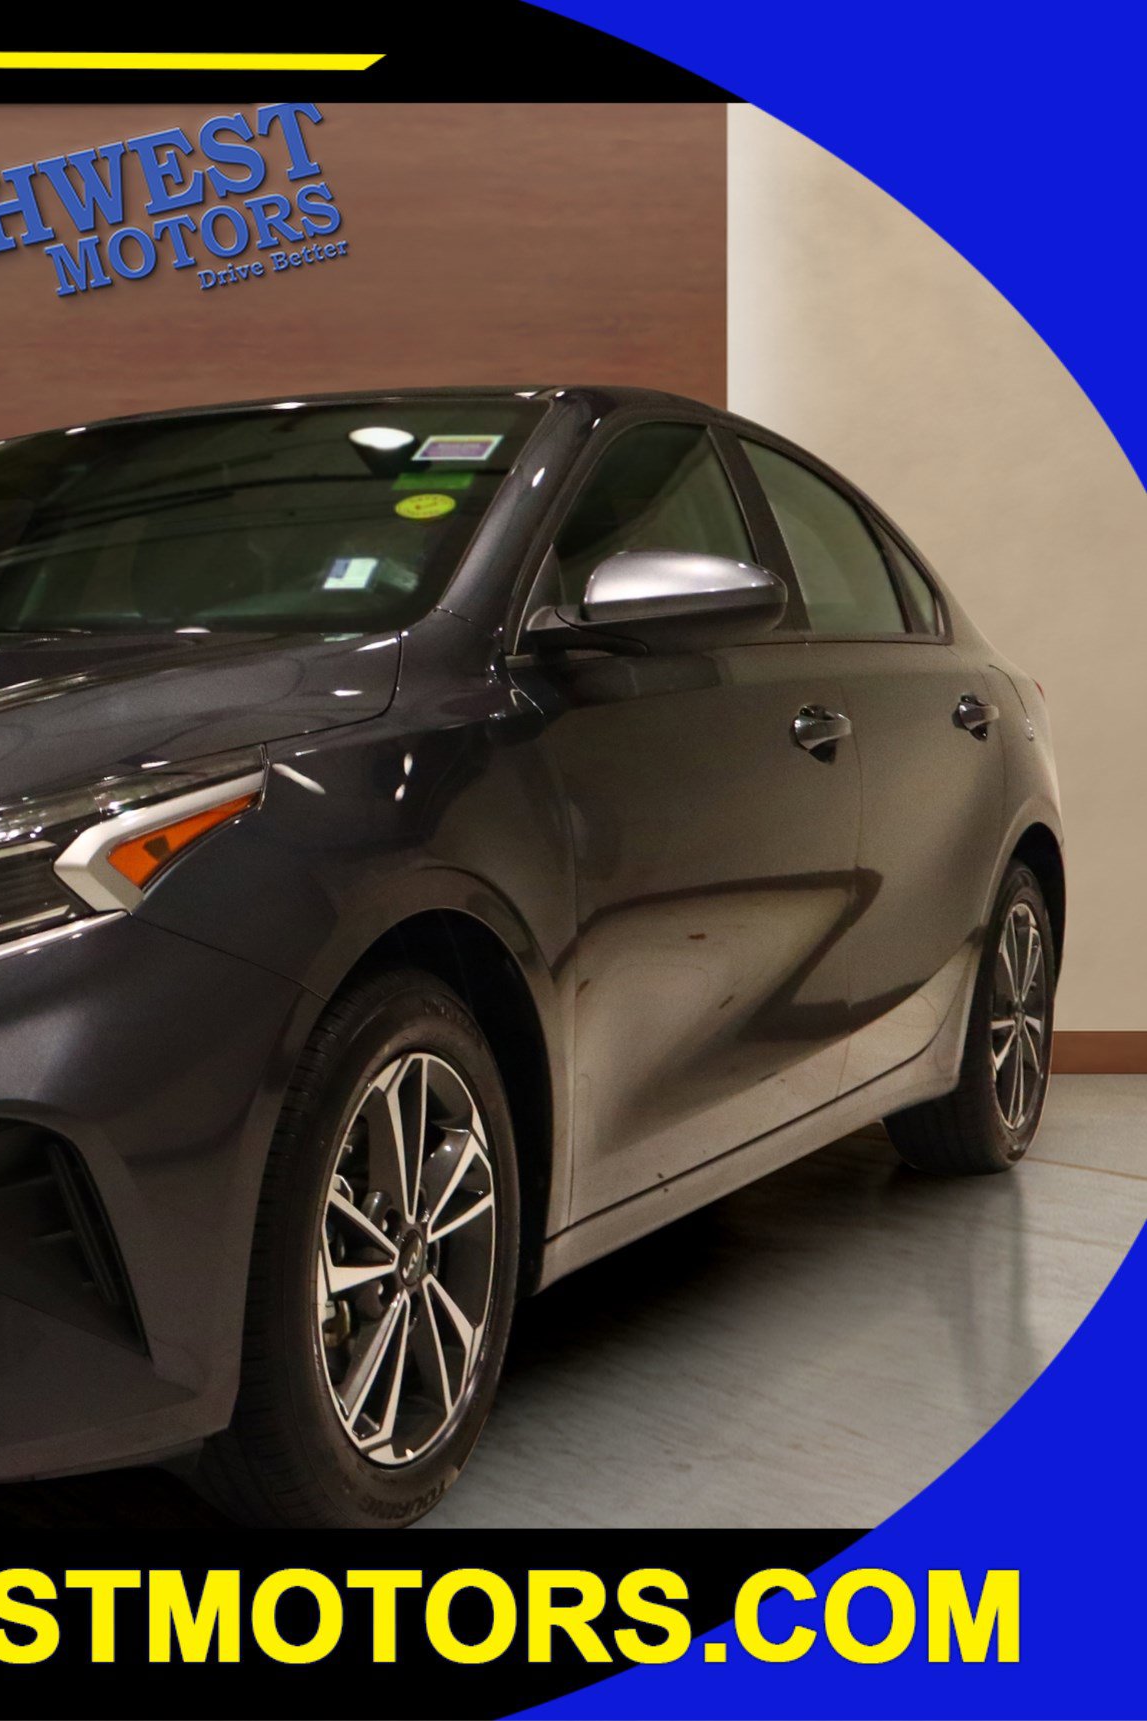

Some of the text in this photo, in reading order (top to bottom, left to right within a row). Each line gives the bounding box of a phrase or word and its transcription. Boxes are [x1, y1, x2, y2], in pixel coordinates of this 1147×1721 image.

[45, 183, 342, 297] MOTORS
[197, 240, 349, 291] Drive Better
